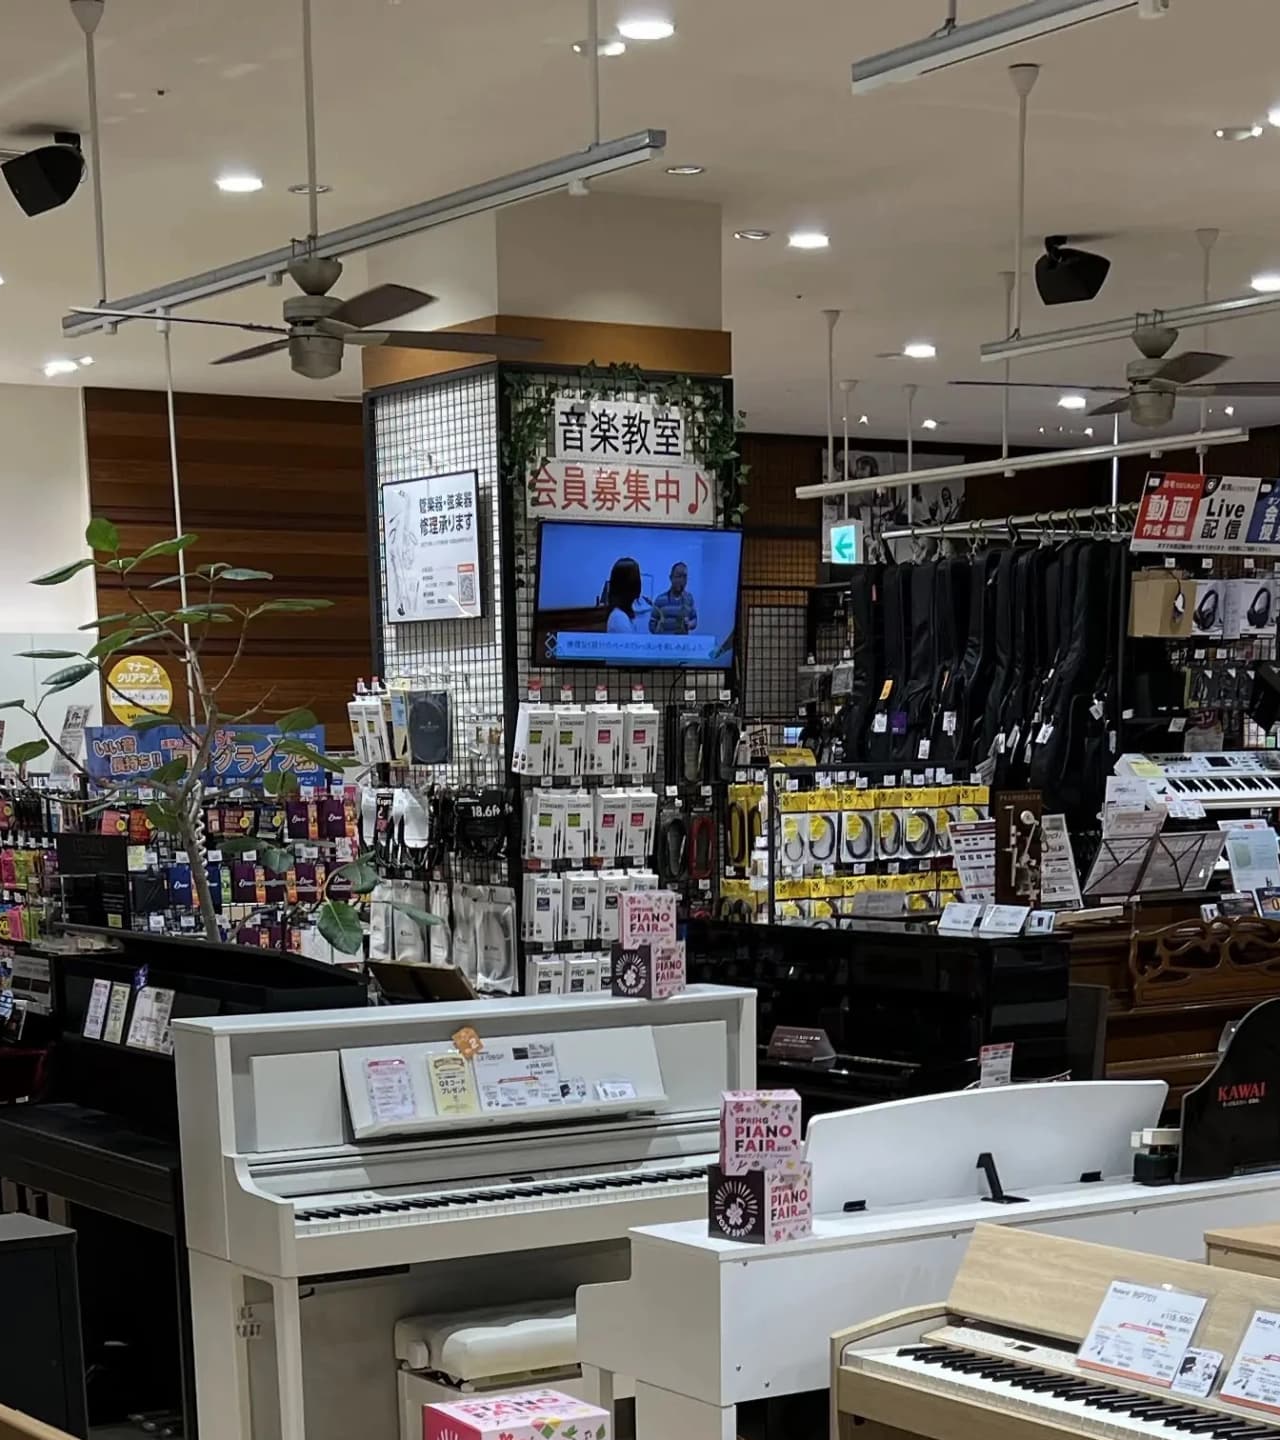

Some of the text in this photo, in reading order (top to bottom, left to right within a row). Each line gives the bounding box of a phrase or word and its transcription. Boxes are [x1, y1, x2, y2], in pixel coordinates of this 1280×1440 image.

[559, 406, 681, 456] 音楽教室
[1145, 494, 1194, 521] 動画
[1206, 498, 1246, 518] Live
[1200, 519, 1242, 540] 配信
[630, 913, 670, 922] PIANO
[630, 923, 659, 933] FAIR
[1218, 1081, 1266, 1102] KAWAI
[736, 1117, 769, 1125] SPRING
[735, 1125, 792, 1138] PIANO
[735, 1139, 776, 1152] FAIR
[771, 1190, 808, 1206] PIANO
[771, 1204, 799, 1221] FAIR
